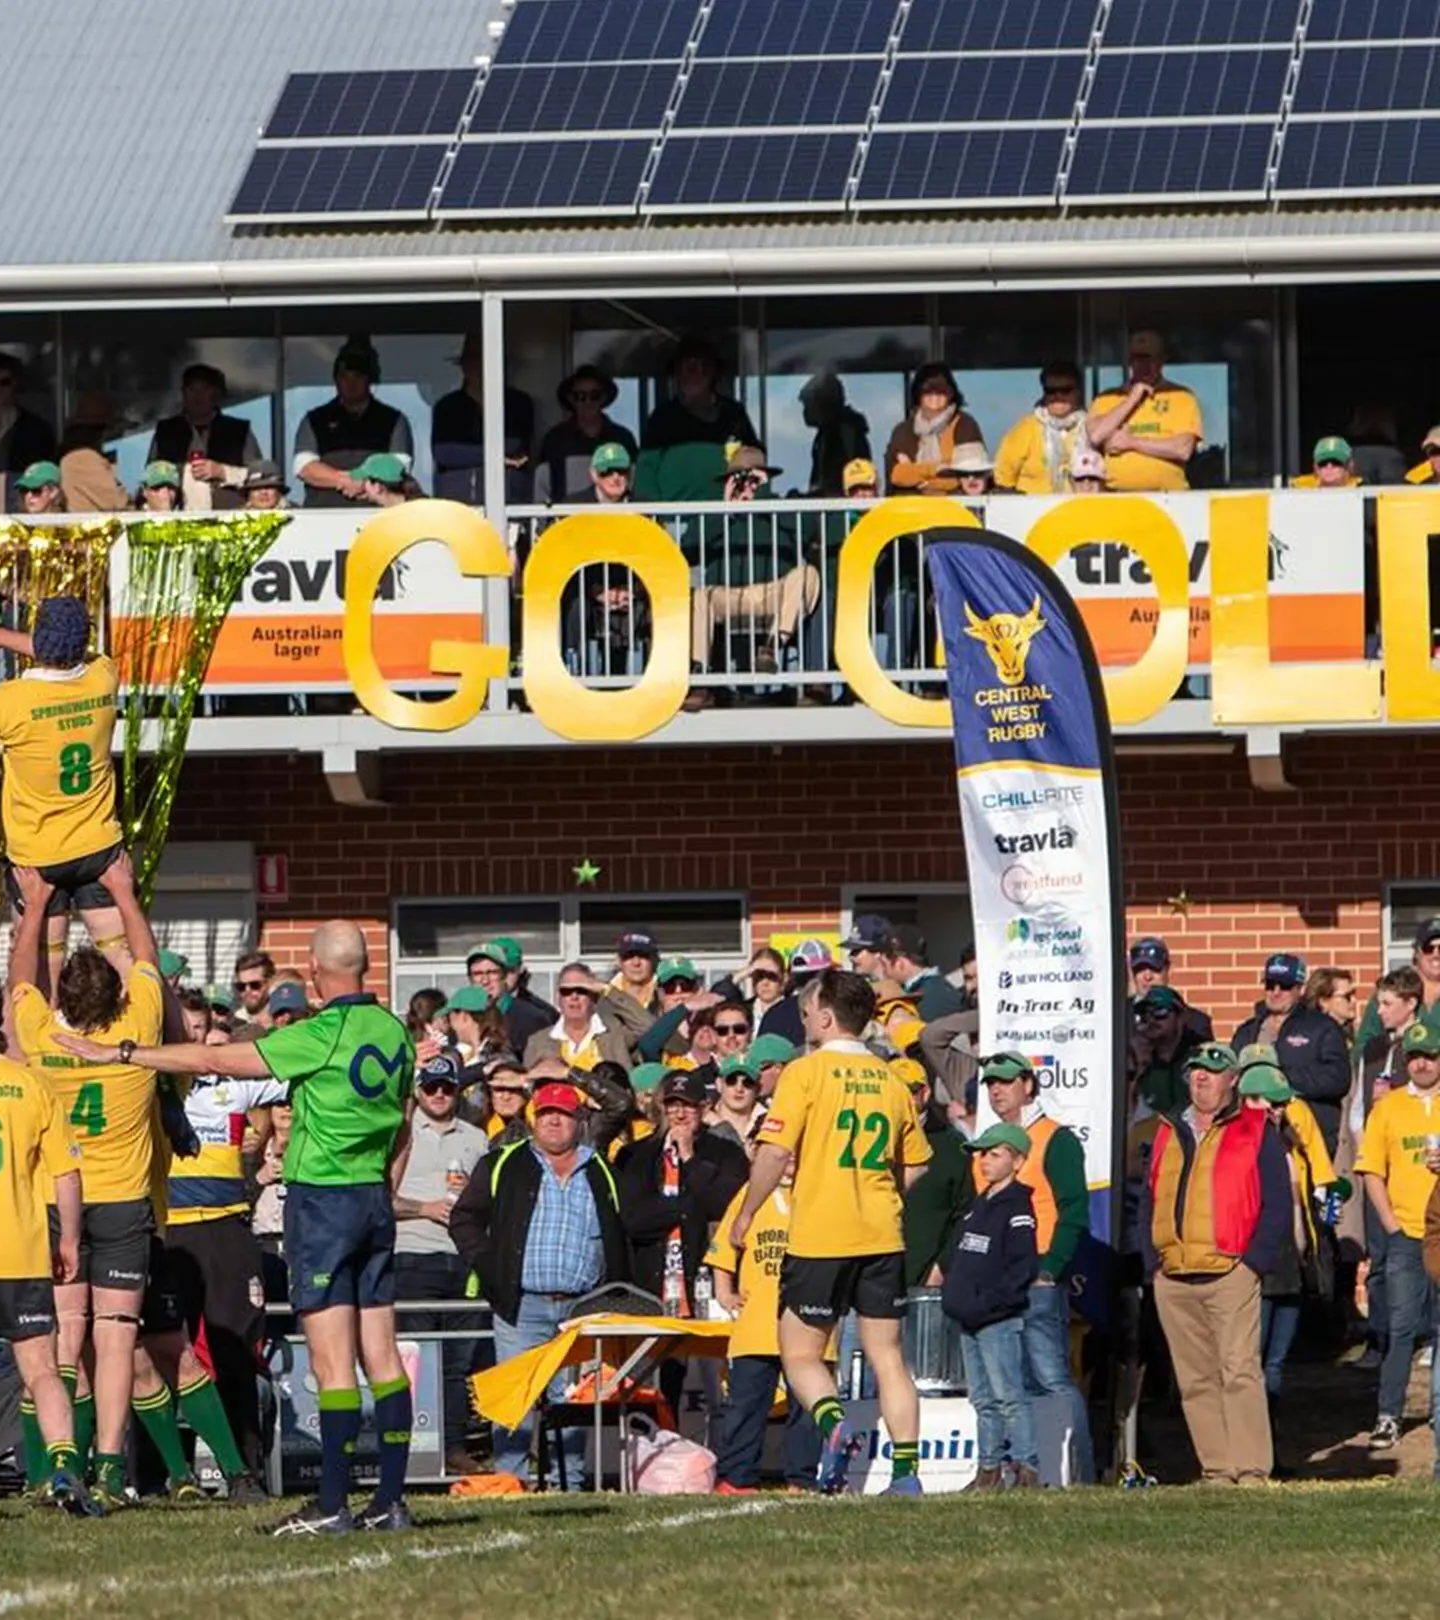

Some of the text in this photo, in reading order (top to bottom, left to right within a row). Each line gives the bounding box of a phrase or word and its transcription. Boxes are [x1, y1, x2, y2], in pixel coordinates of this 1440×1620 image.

[342, 498, 693, 743] GO
[252, 626, 343, 642] Australian
[274, 642, 321, 661] lager
[974, 684, 1052, 706] CENTRAL
[991, 704, 1040, 723] WEST
[988, 722, 1047, 743] RUGBY
[59, 742, 92, 796] 8
[994, 827, 1074, 854] travla
[1016, 970, 1094, 985] NEW HOLLAND
[1069, 997, 1096, 1014] Ag
[70, 1082, 107, 1136] 4
[836, 1108, 890, 1171] 22
